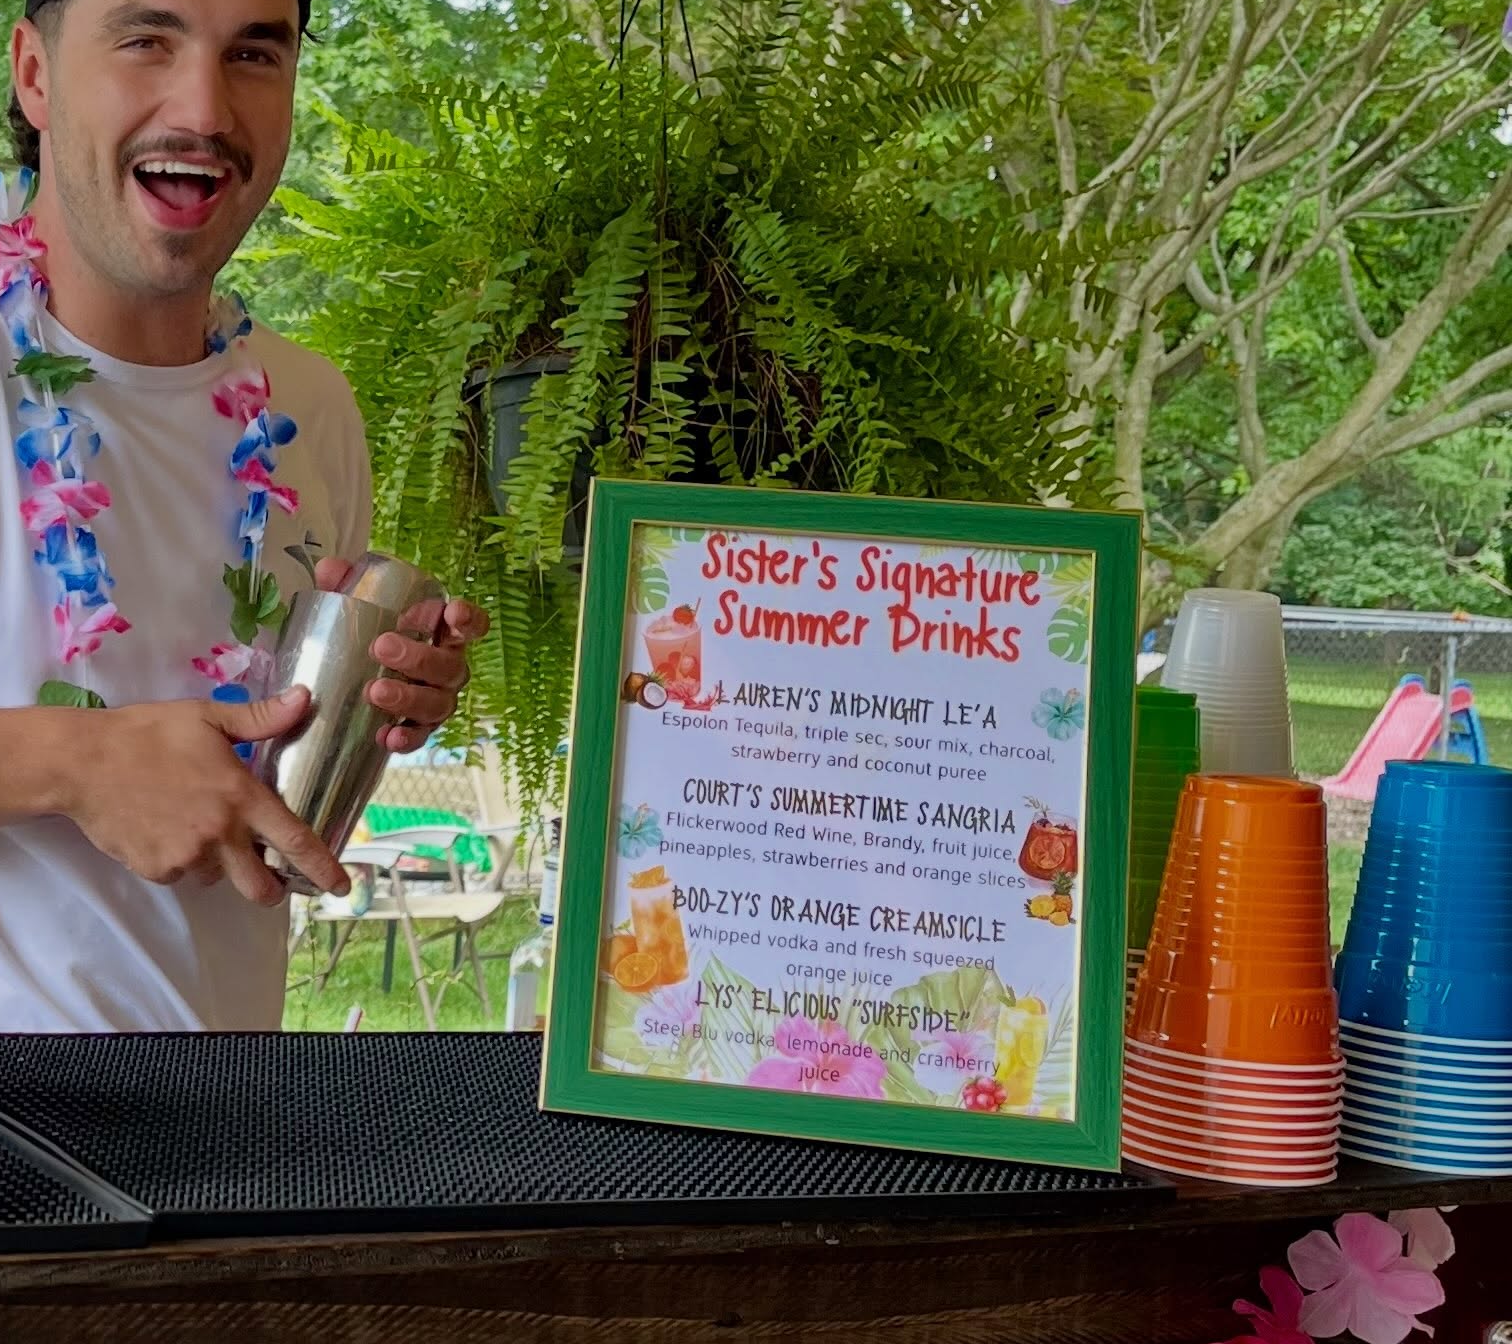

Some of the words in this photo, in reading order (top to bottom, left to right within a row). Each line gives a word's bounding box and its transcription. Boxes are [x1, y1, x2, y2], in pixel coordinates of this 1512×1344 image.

[702, 532, 839, 591] Sister's
[855, 546, 1041, 610] Signature
[714, 589, 870, 648] Summer
[887, 605, 1022, 663] Drinks
[716, 679, 822, 713] LAUREN'S
[829, 690, 935, 726] MIDNIGHT
[661, 711, 729, 731] Espolon
[735, 717, 799, 740] Tequila,
[805, 724, 850, 744] triple
[854, 732, 889, 749] sec,
[894, 735, 933, 751] sour
[938, 738, 974, 757] mix,
[979, 741, 1056, 765] charcoal,
[731, 744, 821, 769] strawberry
[826, 754, 859, 770] and
[864, 758, 932, 777] coconut
[938, 765, 987, 782] puree
[683, 777, 763, 809] COURT'S
[770, 786, 909, 824] SUMMERTIME
[916, 801, 1016, 835] SANGRIA
[666, 811, 769, 836] Flickerwood
[774, 822, 807, 840] Red
[812, 826, 857, 847] Wine,
[863, 831, 926, 855] Brandy,
[932, 837, 968, 857] fruit
[971, 844, 1017, 864] juice,
[659, 839, 757, 864] pineapples,
[762, 848, 869, 873] strawberries
[874, 860, 906, 877] and
[911, 865, 973, 886] orange
[977, 869, 1026, 889] slices
[672, 885, 762, 919] BOO-ZY'S
[771, 894, 861, 932] ORANGE
[869, 904, 1008, 943] CREAMSICLE
[688, 923, 762, 946] Whipped
[767, 933, 819, 953] vodka
[824, 940, 857, 957] and
[863, 941, 907, 962] fresh
[912, 951, 996, 972] squeezed
[785, 962, 847, 984] orange
[851, 967, 893, 987] juice
[751, 987, 841, 1022] ELICIOUS
[642, 1018, 686, 1037] Steel
[691, 1023, 719, 1042] Blu
[787, 1035, 874, 1060] lemonade
[879, 1047, 912, 1064] and
[917, 1050, 1001, 1077] cranberry
[797, 1065, 841, 1083] juice
